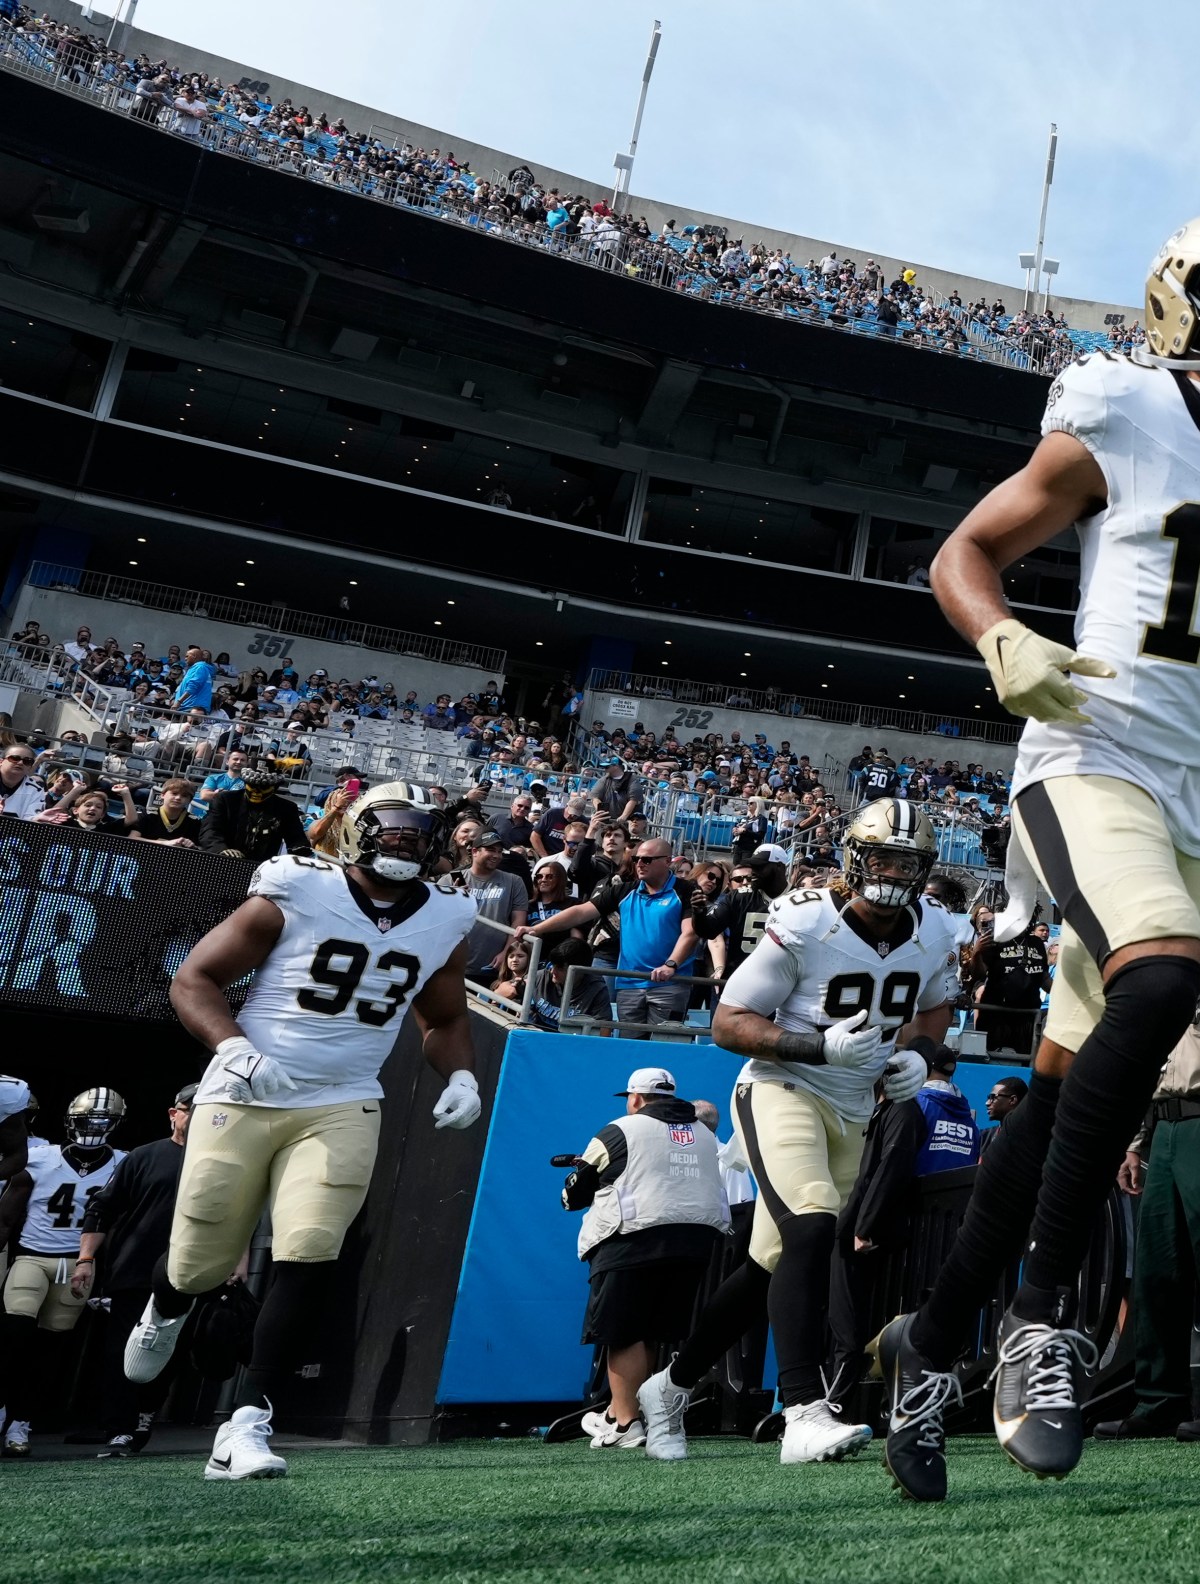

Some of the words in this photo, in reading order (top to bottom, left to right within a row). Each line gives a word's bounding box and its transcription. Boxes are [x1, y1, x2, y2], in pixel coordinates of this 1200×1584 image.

[1104, 313, 1126, 326] 551
[247, 632, 296, 658] 351
[669, 706, 714, 730] 252
[868, 771, 888, 788] 30
[39, 843, 140, 900] OUR
[297, 937, 421, 1028] 93
[815, 971, 921, 1043] 99
[672, 1130, 693, 1144] NFL
[934, 1120, 973, 1140] BEST
[669, 1152, 699, 1165] MEDIA
[669, 1165, 700, 1178] NO-040
